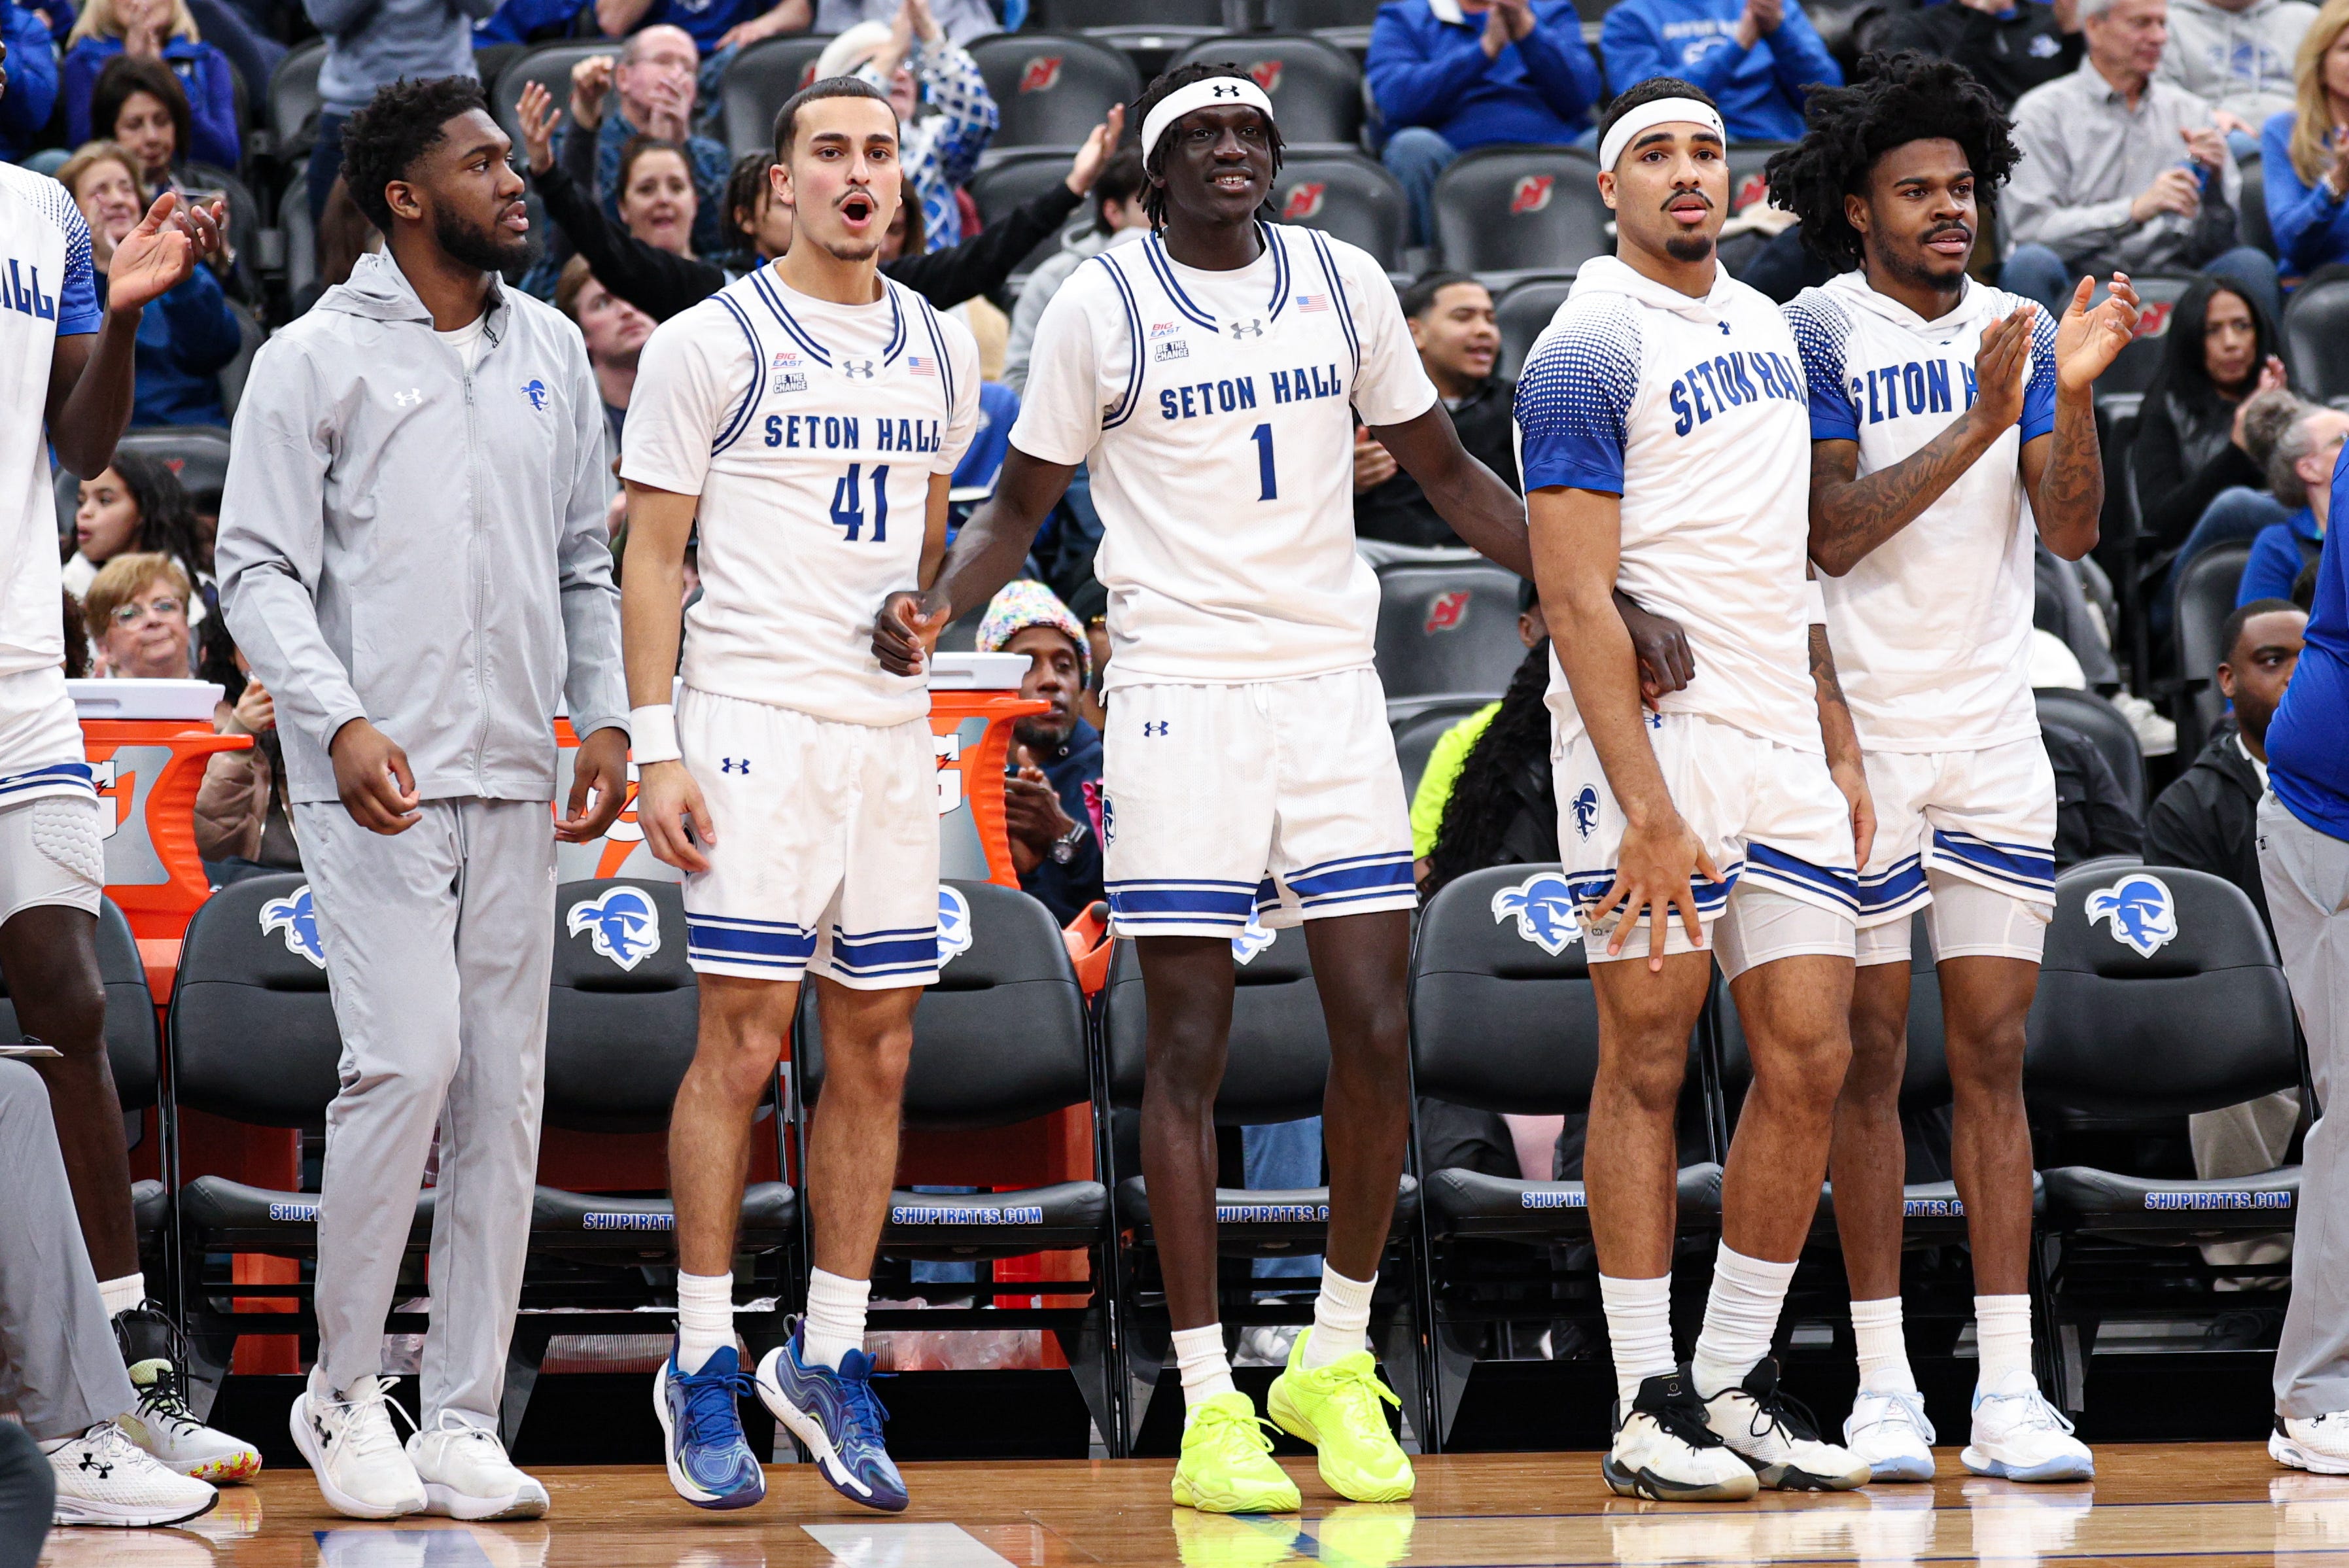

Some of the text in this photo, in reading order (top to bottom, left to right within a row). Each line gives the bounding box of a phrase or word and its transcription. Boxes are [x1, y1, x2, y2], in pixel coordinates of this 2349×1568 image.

[1151, 326, 1181, 337] EAST
[1153, 322, 1173, 330] BIG
[1155, 347, 1189, 362] CHANGE
[1157, 340, 1185, 353] BE THE
[774, 381, 807, 393] CHANGE
[775, 373, 804, 385] BE THE
[1159, 364, 1342, 420] SETON HALL
[1669, 351, 1808, 437] SETON HAL
[765, 415, 941, 453] SETON HALL
[1250, 423, 1278, 502] 1
[829, 463, 890, 542] 41
[2145, 1191, 2291, 1210] SHUPIRATES.COM
[892, 1206, 1043, 1225] SHUPIRATES.COM
